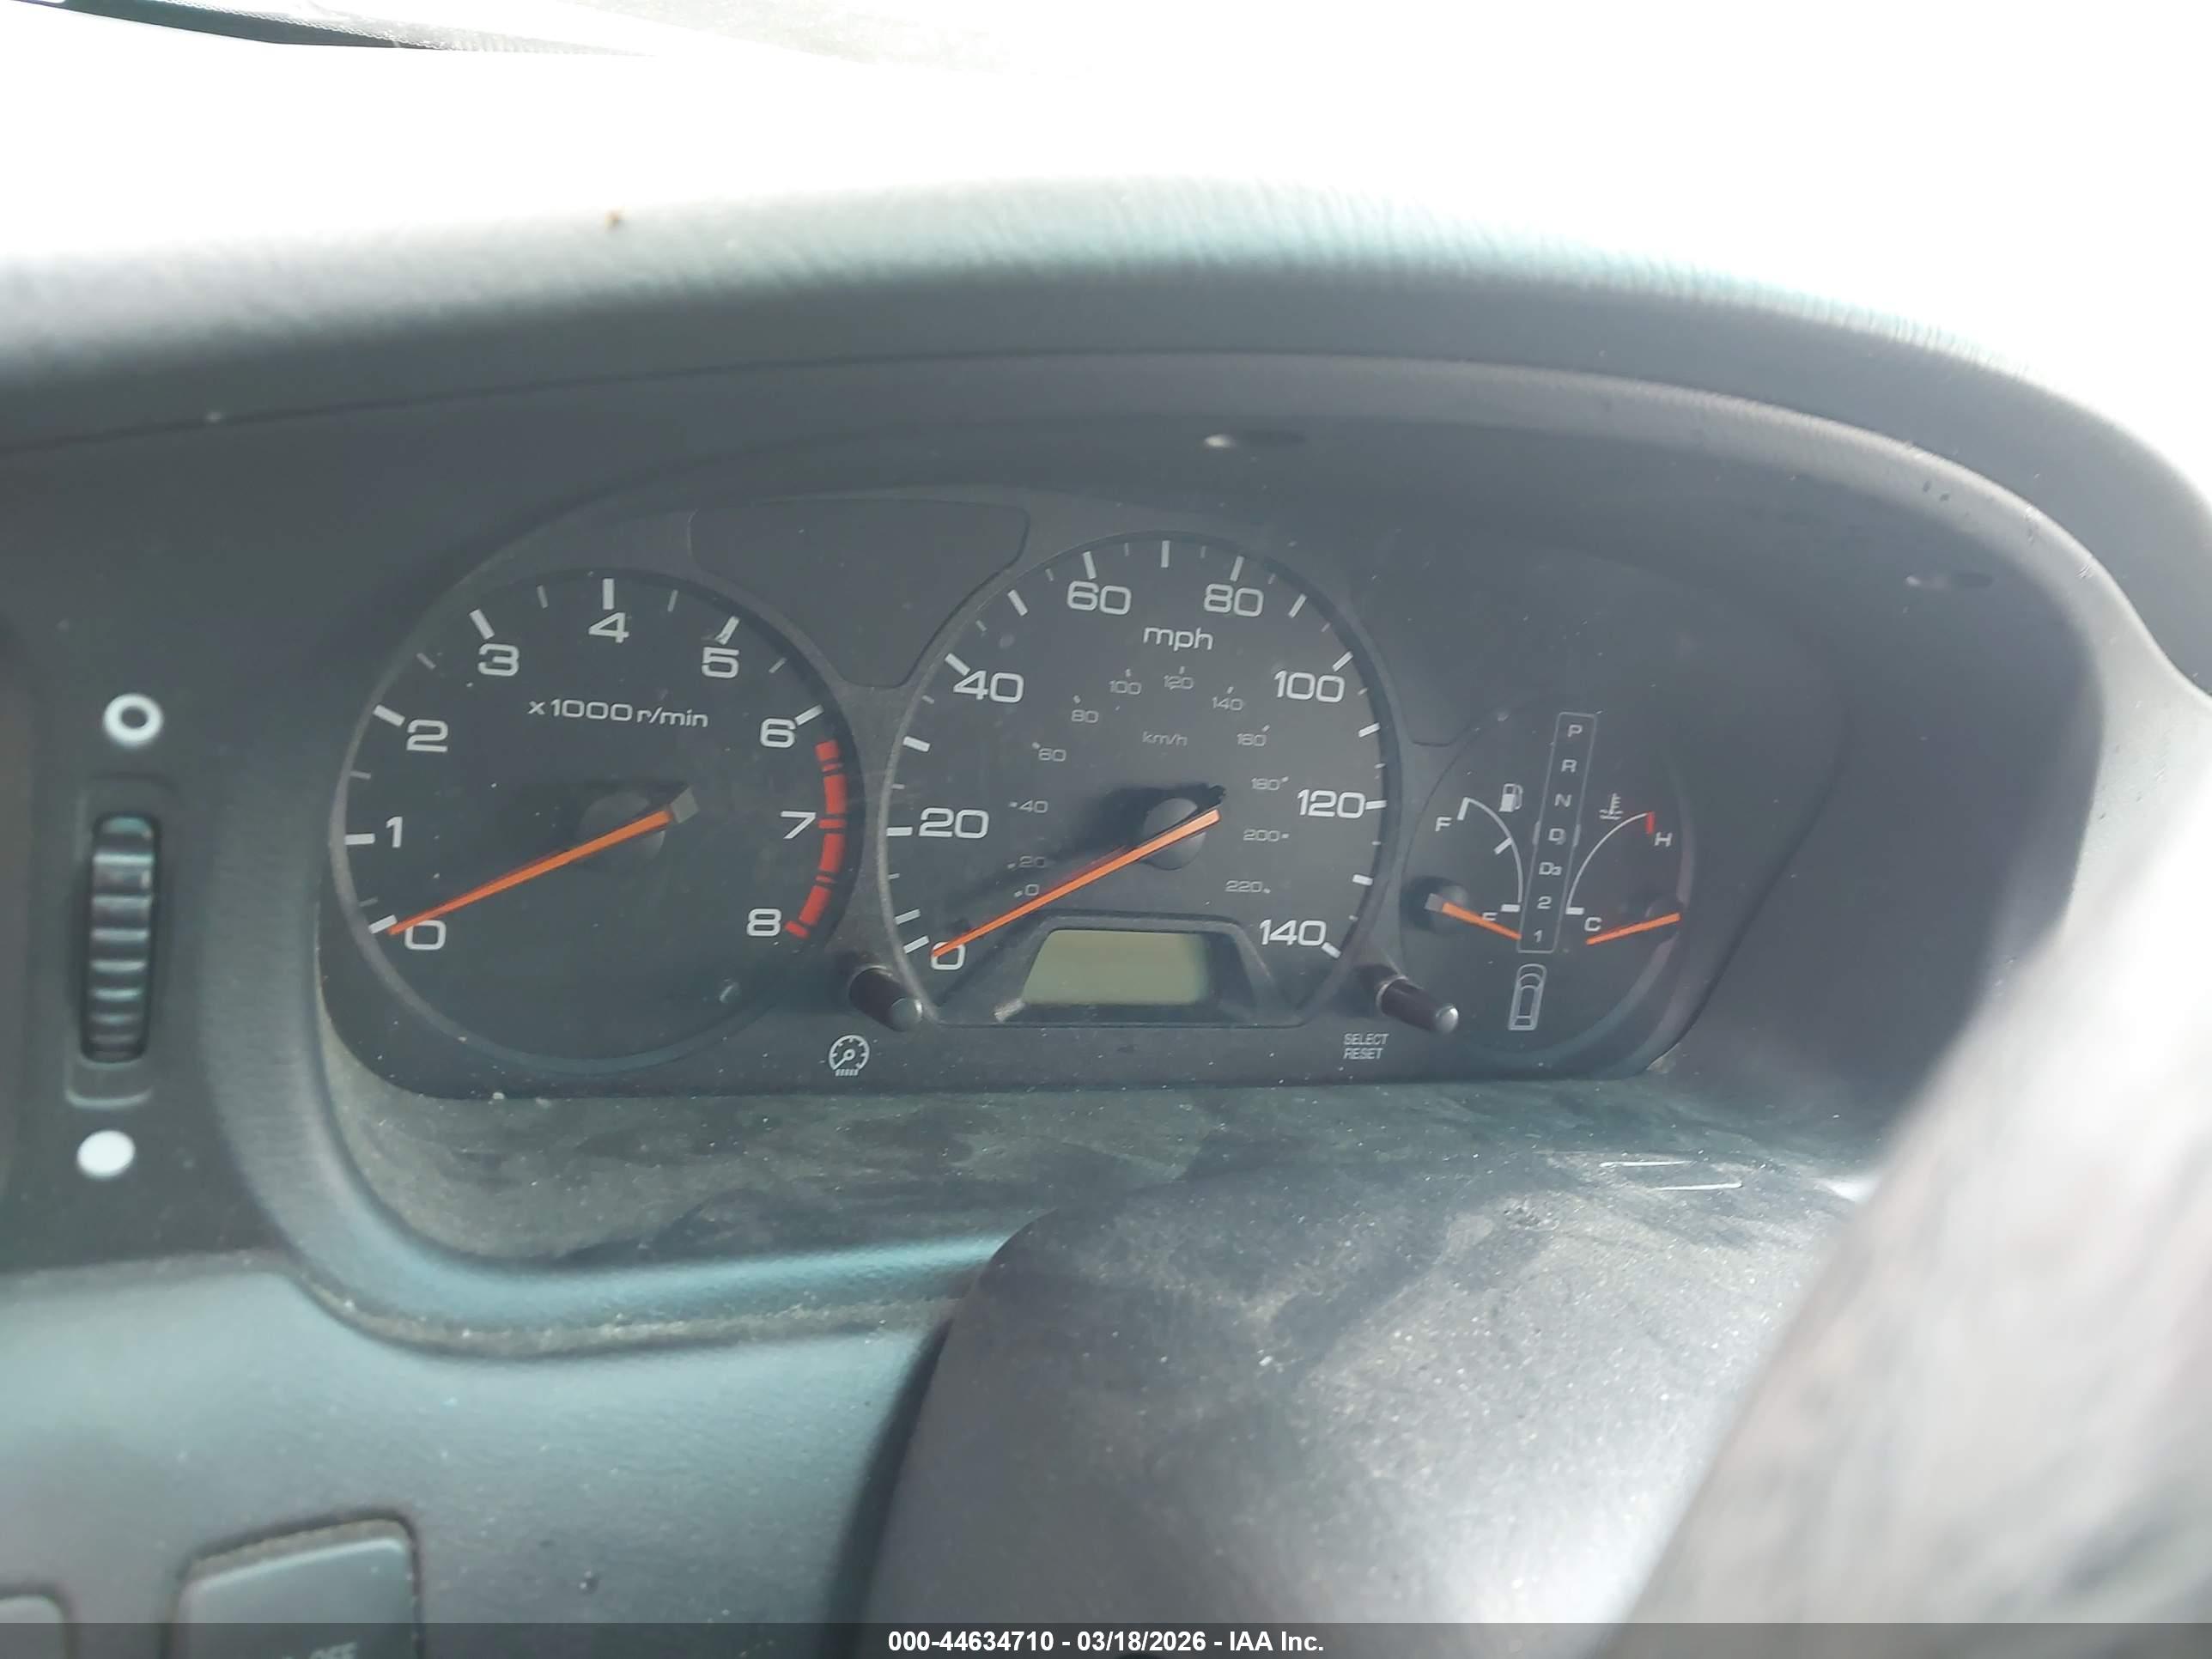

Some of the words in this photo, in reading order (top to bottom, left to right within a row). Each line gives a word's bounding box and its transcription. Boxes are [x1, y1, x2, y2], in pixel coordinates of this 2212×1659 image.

[1067, 581, 1131, 615] 60
[1204, 584, 1263, 617] 80
[589, 612, 629, 643] 4
[1144, 628, 1212, 651] mph
[478, 644, 519, 676] 3
[702, 647, 738, 678] 5
[953, 670, 1024, 703] 40
[1109, 680, 1141, 695] 100
[1164, 675, 1194, 690] 120
[1274, 670, 1346, 703] 100
[1212, 697, 1243, 710] 140
[637, 708, 708, 727] r/min
[1071, 708, 1099, 723] 80
[407, 720, 447, 752] 2
[761, 719, 795, 747] 6
[1143, 732, 1188, 745] km/h
[1568, 725, 1583, 737] P
[1561, 759, 1577, 772] R
[1252, 778, 1279, 790] 180
[1019, 800, 1048, 812] 40
[1297, 789, 1366, 818] 120
[1554, 793, 1571, 807] N
[781, 811, 816, 838] 7
[919, 808, 988, 838] 20
[1436, 817, 1451, 831] F
[386, 817, 402, 848] 1
[1243, 830, 1279, 842] 200
[1655, 832, 1672, 847] H
[1019, 856, 1045, 867] 20
[1025, 884, 1039, 896] 0
[1225, 880, 1262, 892] 220
[1537, 896, 1551, 908] 2
[747, 908, 781, 936] 8
[1585, 917, 1601, 931] C
[404, 920, 446, 951] 0
[1260, 920, 1327, 946] 140
[1534, 930, 1542, 942] 1
[931, 942, 965, 969] 0
[1344, 1034, 1389, 1044] SELECT
[1344, 1048, 1382, 1059] RESET
